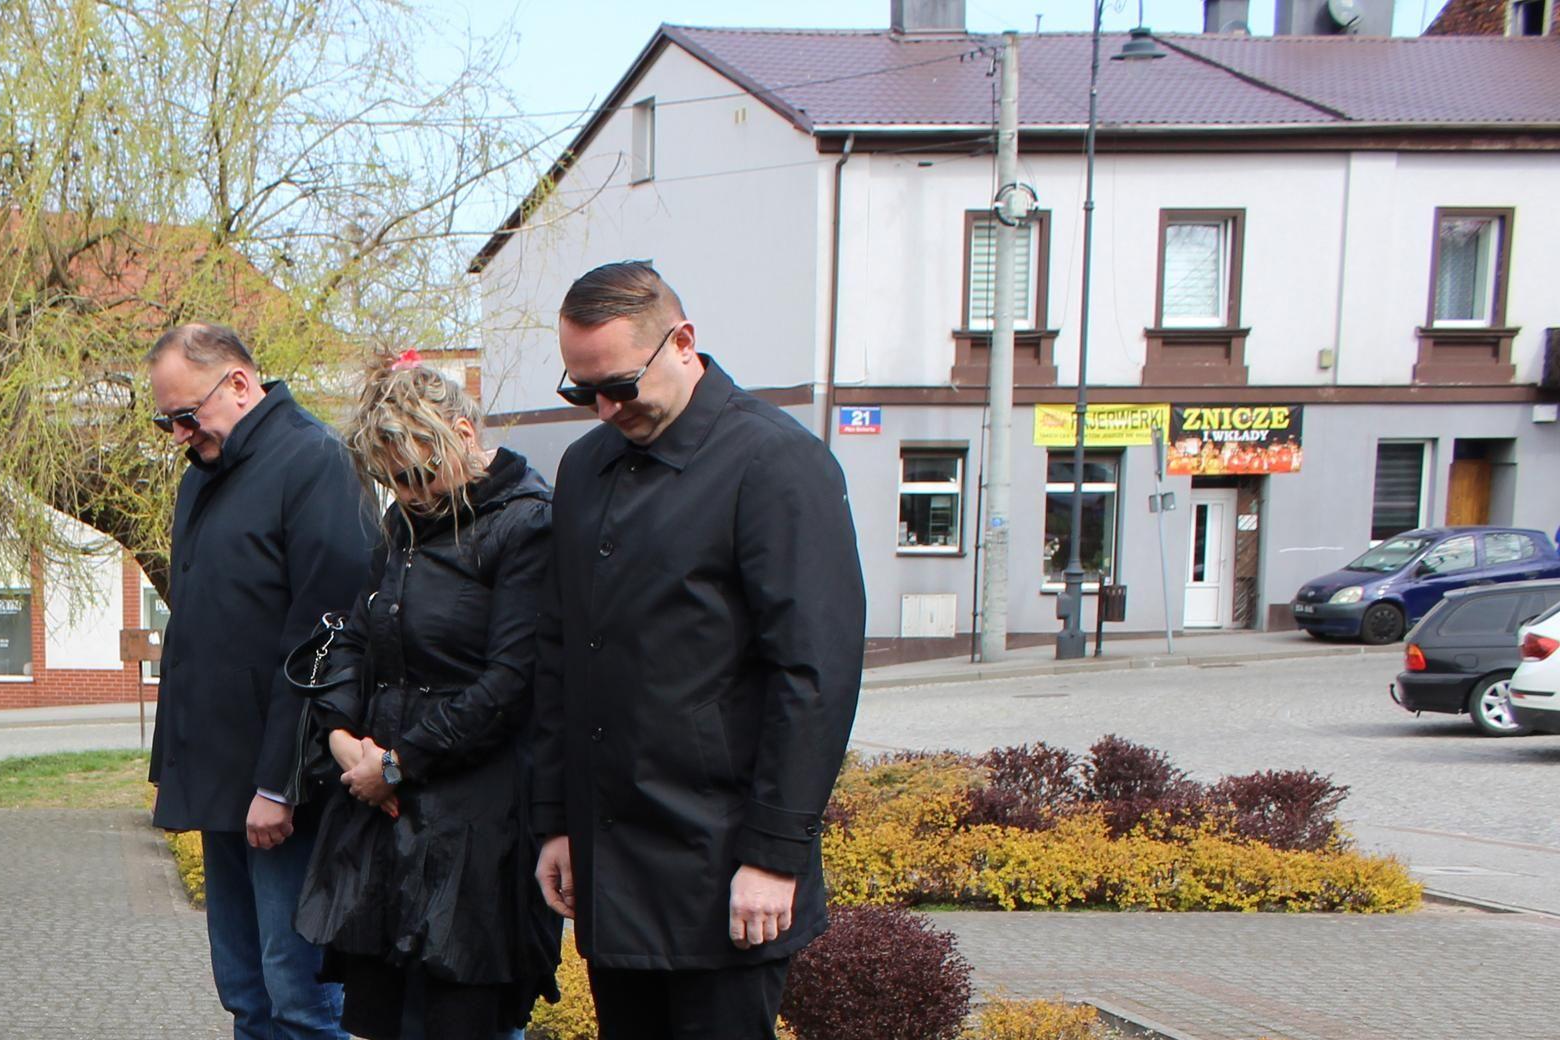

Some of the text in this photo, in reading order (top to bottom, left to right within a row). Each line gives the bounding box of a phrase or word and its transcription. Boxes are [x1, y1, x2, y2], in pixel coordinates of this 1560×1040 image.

[851, 410, 870, 426] 21
[1182, 406, 1290, 430] ZNICZE
[1202, 429, 1270, 442] I WKŁADY
